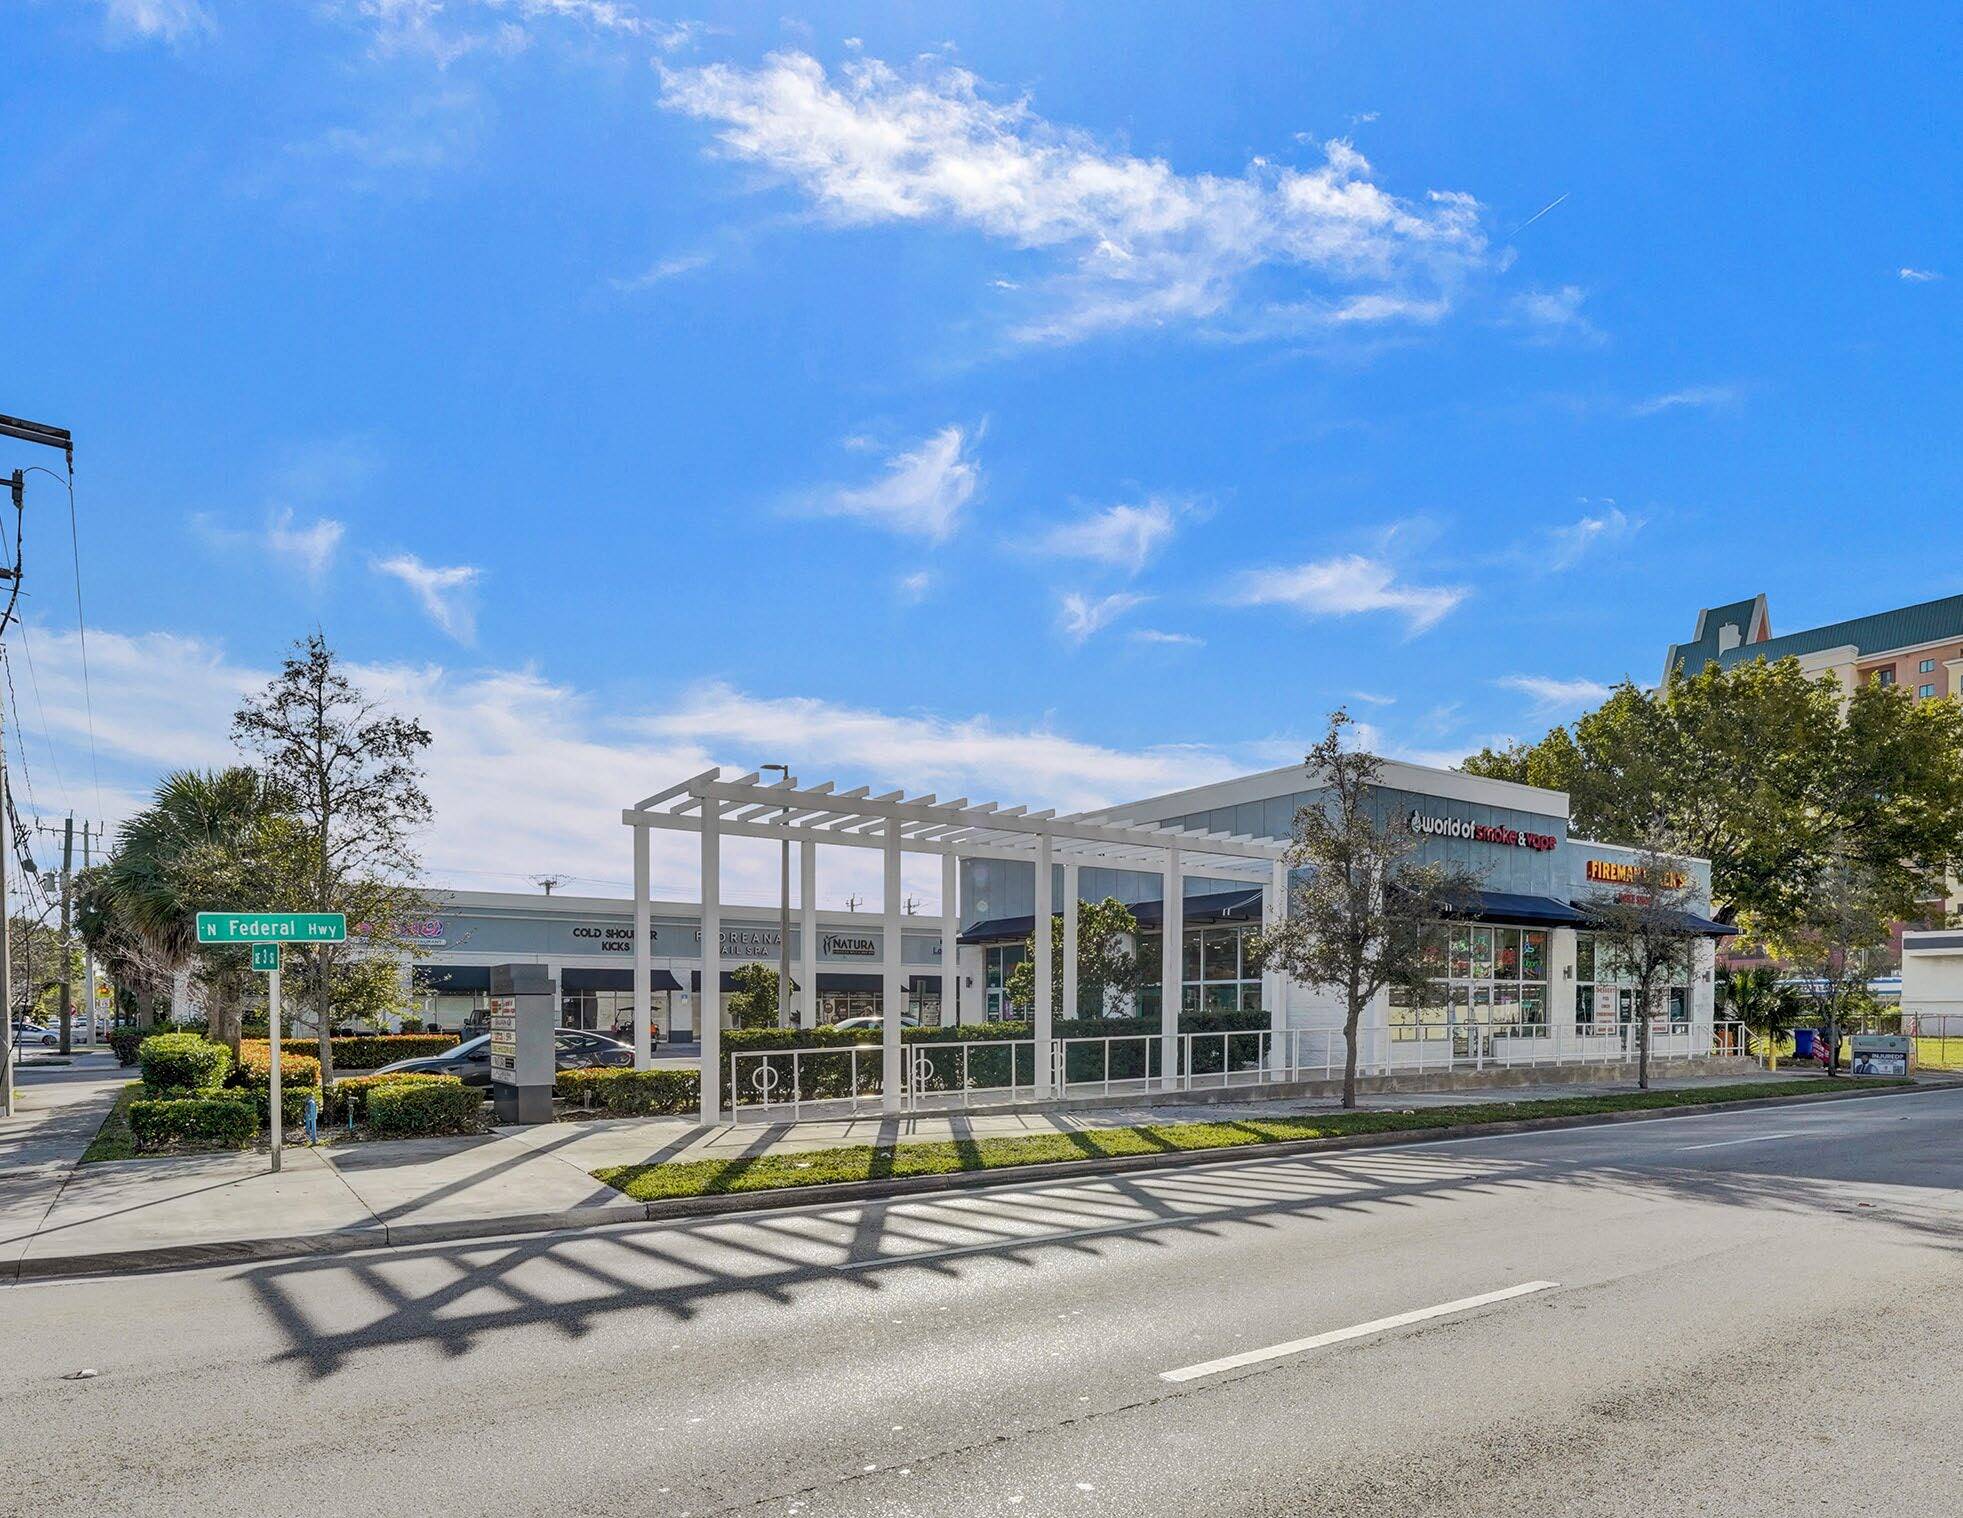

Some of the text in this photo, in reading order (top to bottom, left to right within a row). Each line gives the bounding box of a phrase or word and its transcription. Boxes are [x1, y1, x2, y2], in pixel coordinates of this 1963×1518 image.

[1421, 816, 1557, 852] world of smoke & vape
[207, 920, 337, 938] N Federal Hwy
[572, 927, 658, 940] COLD SHOUR
[694, 931, 782, 944] FOREANA
[832, 938, 875, 950] NATURA
[601, 941, 631, 952] KICKS
[720, 946, 769, 956] AIL SPA
